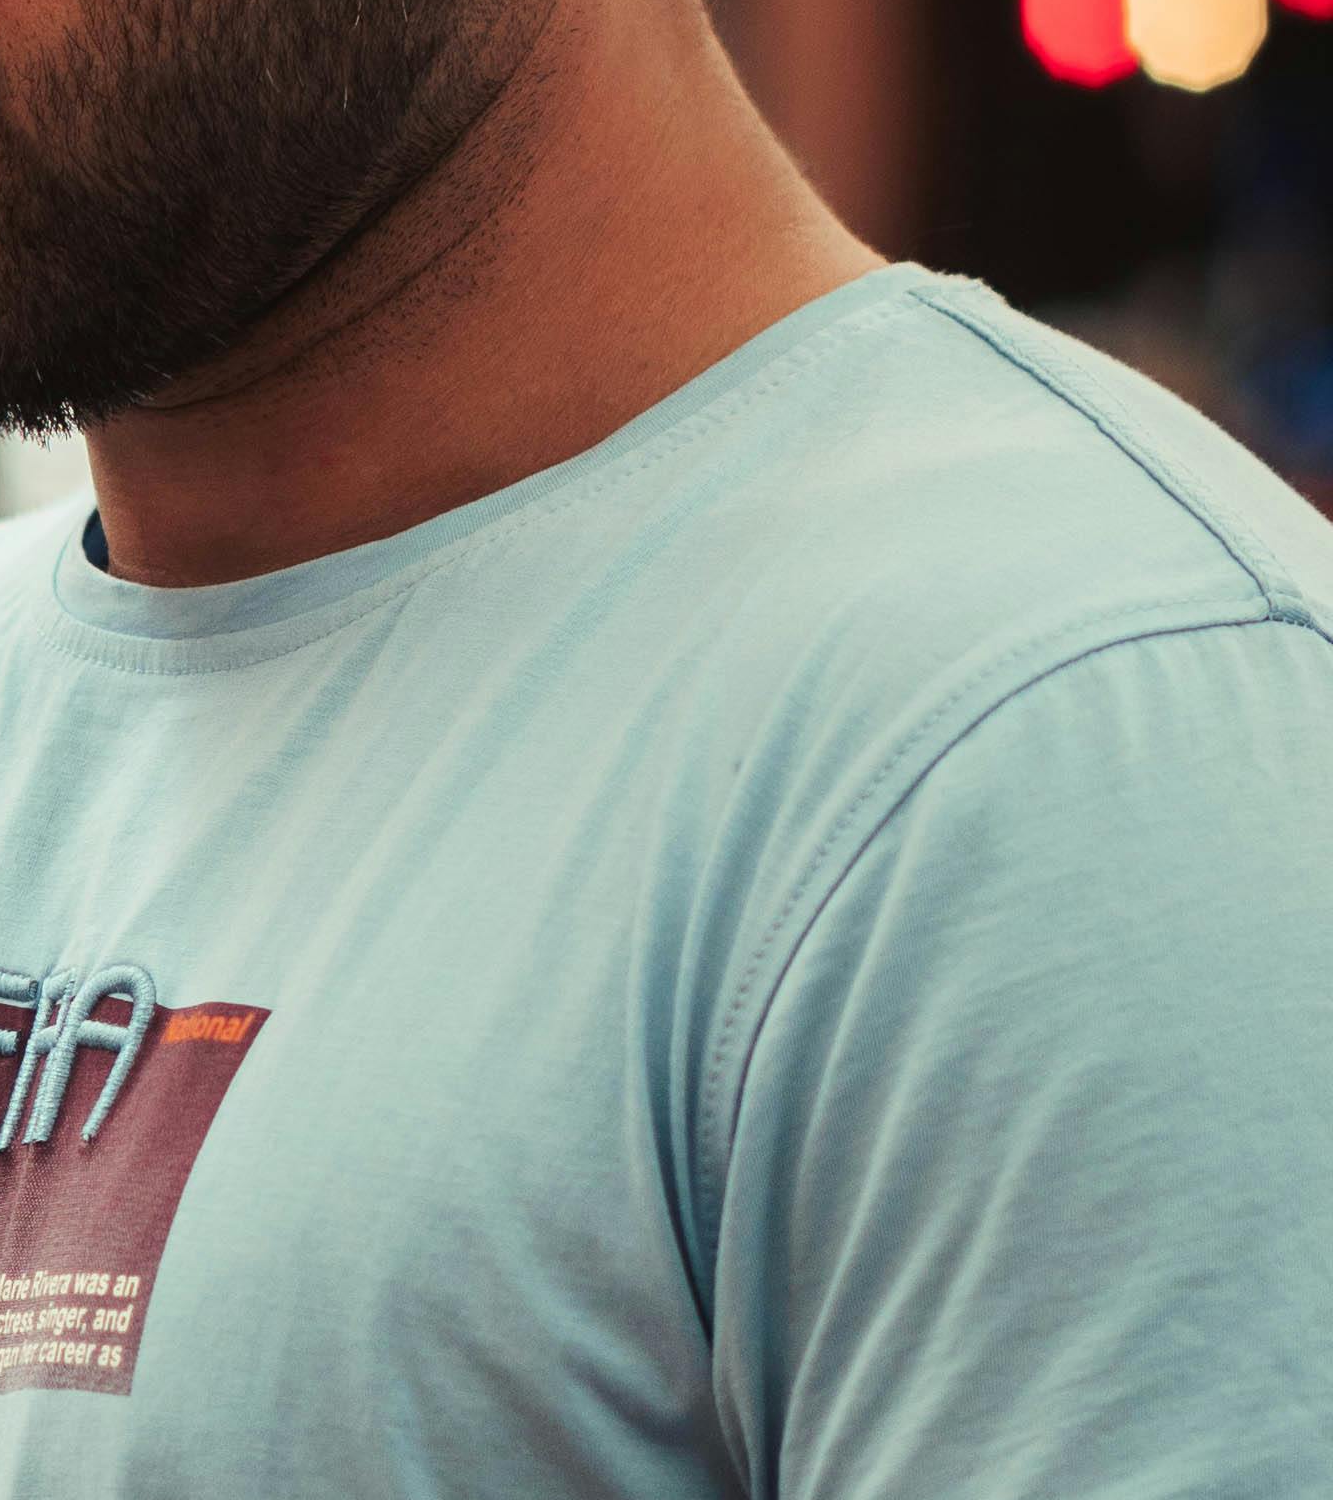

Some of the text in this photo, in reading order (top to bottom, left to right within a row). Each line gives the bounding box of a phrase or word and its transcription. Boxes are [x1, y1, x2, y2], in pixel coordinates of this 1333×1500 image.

[31, 1270, 72, 1298] Rivera
[74, 1273, 110, 1296] was
[113, 1274, 141, 1298] an
[37, 1302, 87, 1336] singer,
[93, 1304, 134, 1333] and
[38, 1341, 96, 1365] career
[97, 1344, 123, 1368] as
